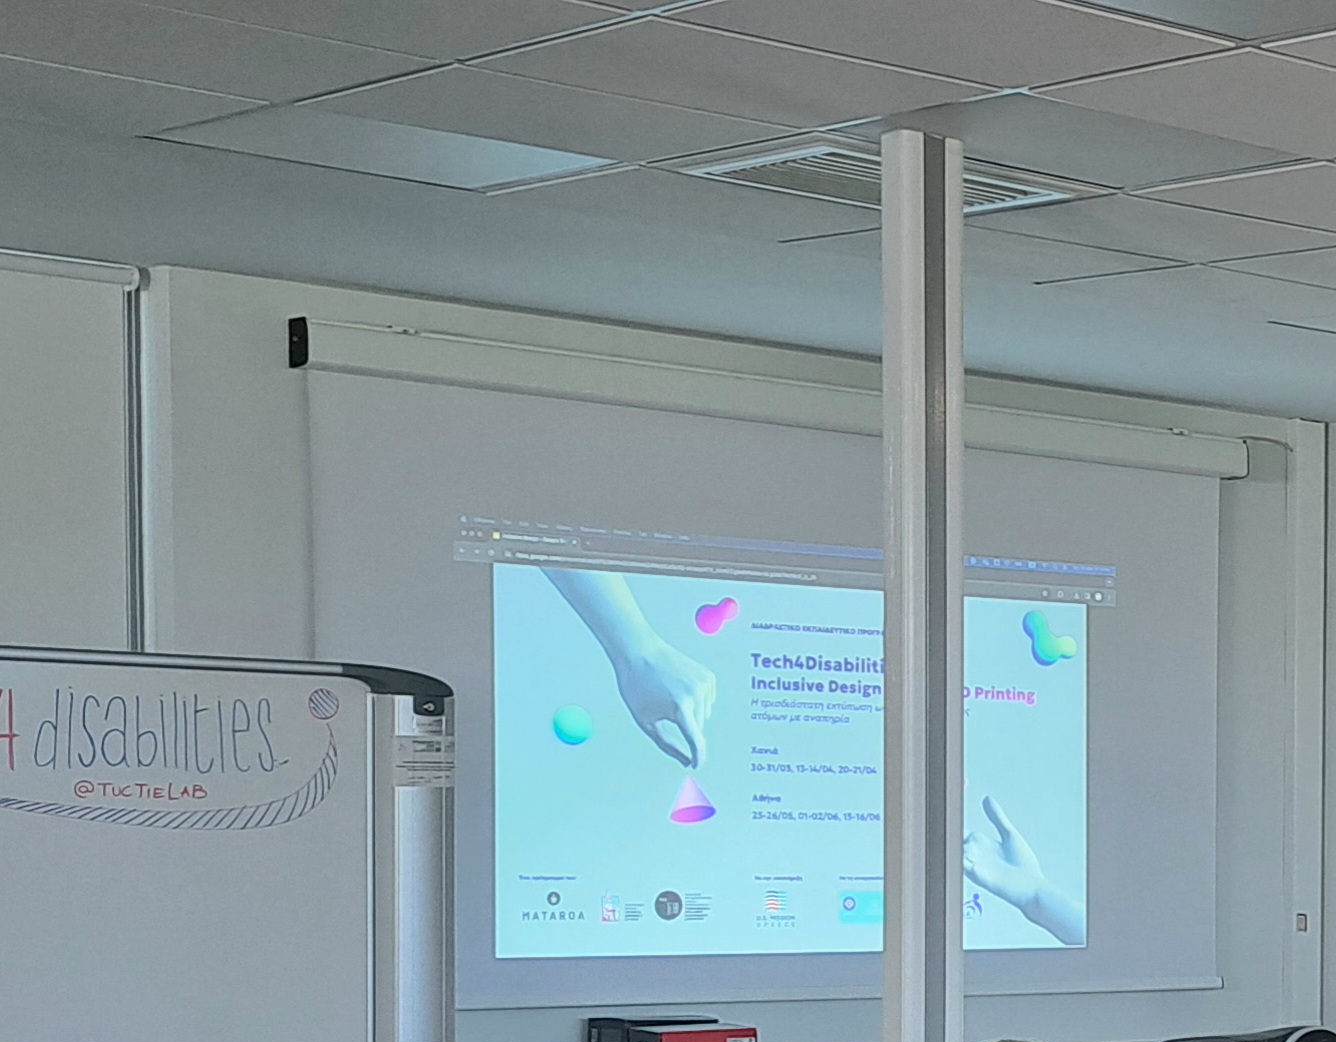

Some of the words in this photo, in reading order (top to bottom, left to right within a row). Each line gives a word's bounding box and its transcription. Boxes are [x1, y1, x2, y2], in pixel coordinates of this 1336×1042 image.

[750, 652, 885, 674] Tech4Disabiliti
[751, 676, 824, 693] Inclusive
[828, 679, 882, 698] Design
[974, 686, 1036, 705] Printing
